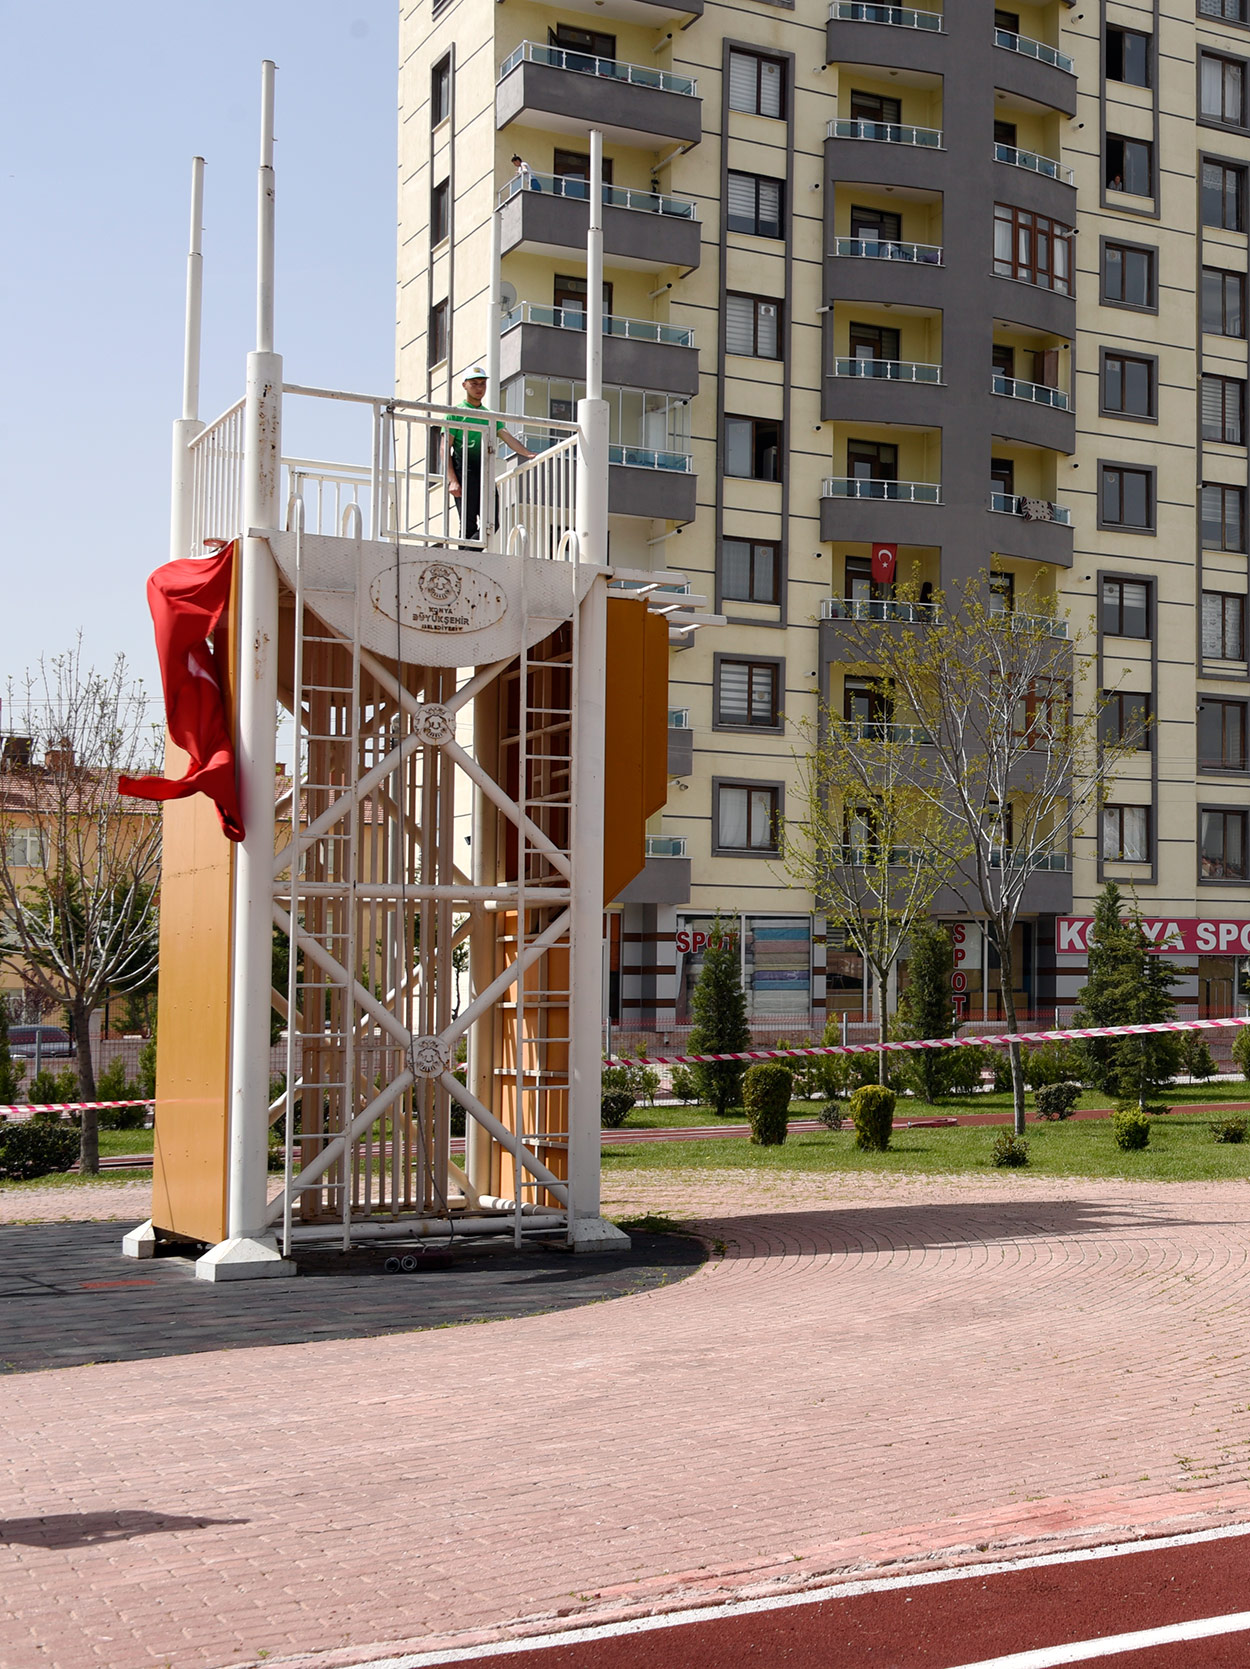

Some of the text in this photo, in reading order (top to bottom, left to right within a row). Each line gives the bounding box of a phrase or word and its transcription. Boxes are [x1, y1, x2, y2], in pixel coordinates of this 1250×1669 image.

[412, 612, 470, 625] BÜYÜKŞEHİR
[1060, 921, 1186, 951] KYA
[952, 923, 967, 1016] SPOT
